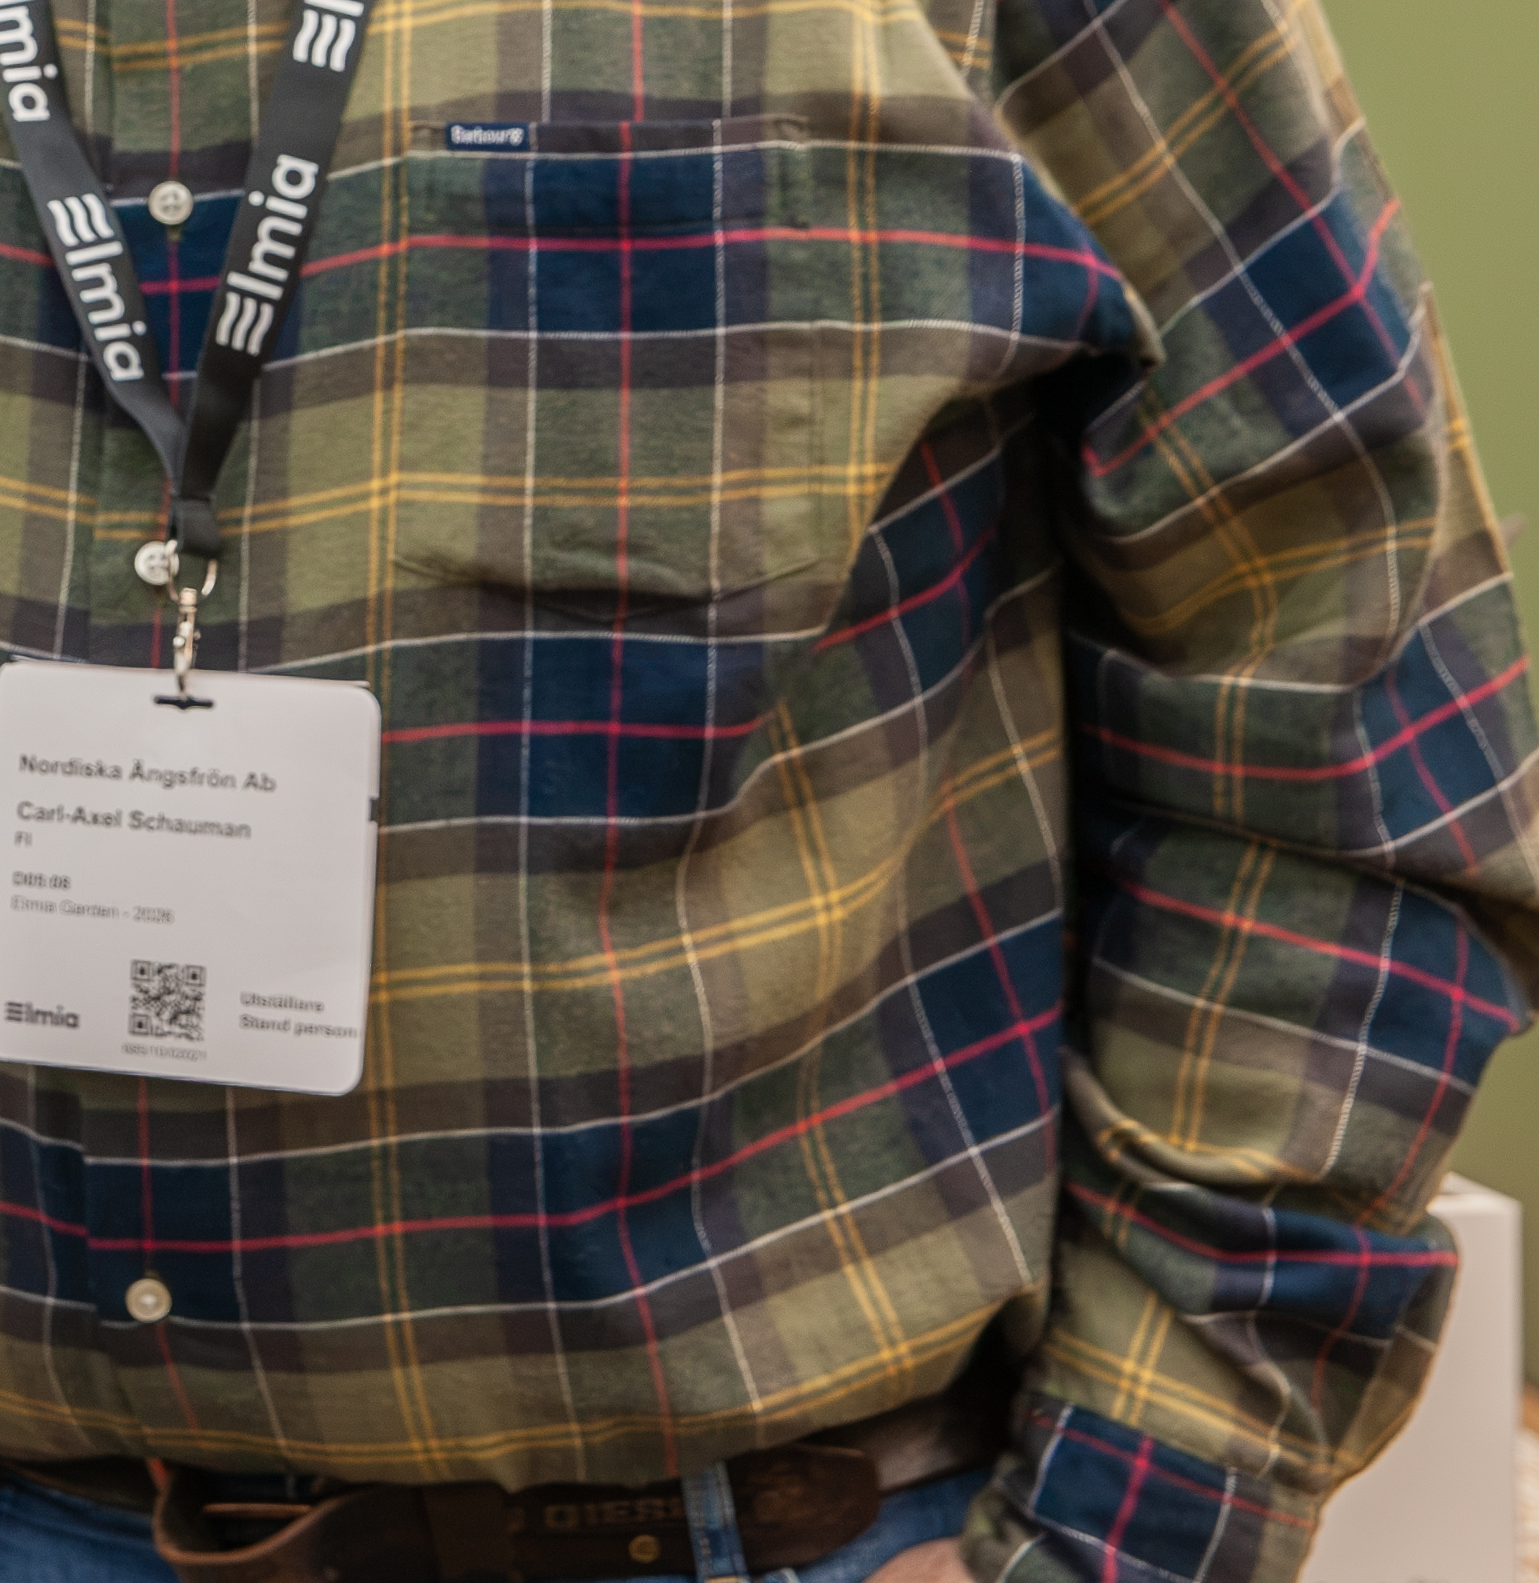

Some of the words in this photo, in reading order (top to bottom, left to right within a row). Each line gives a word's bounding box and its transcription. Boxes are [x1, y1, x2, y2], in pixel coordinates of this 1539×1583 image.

[215, 153, 320, 357] Elmia
[48, 192, 147, 384] Elmia
[19, 754, 123, 781] Nordiska
[129, 758, 236, 789] Ängsfrön
[242, 771, 278, 793] Ab
[17, 800, 122, 827] Carl-Axel
[128, 810, 252, 839] Schauman
[5, 1001, 80, 1028] Elmia
